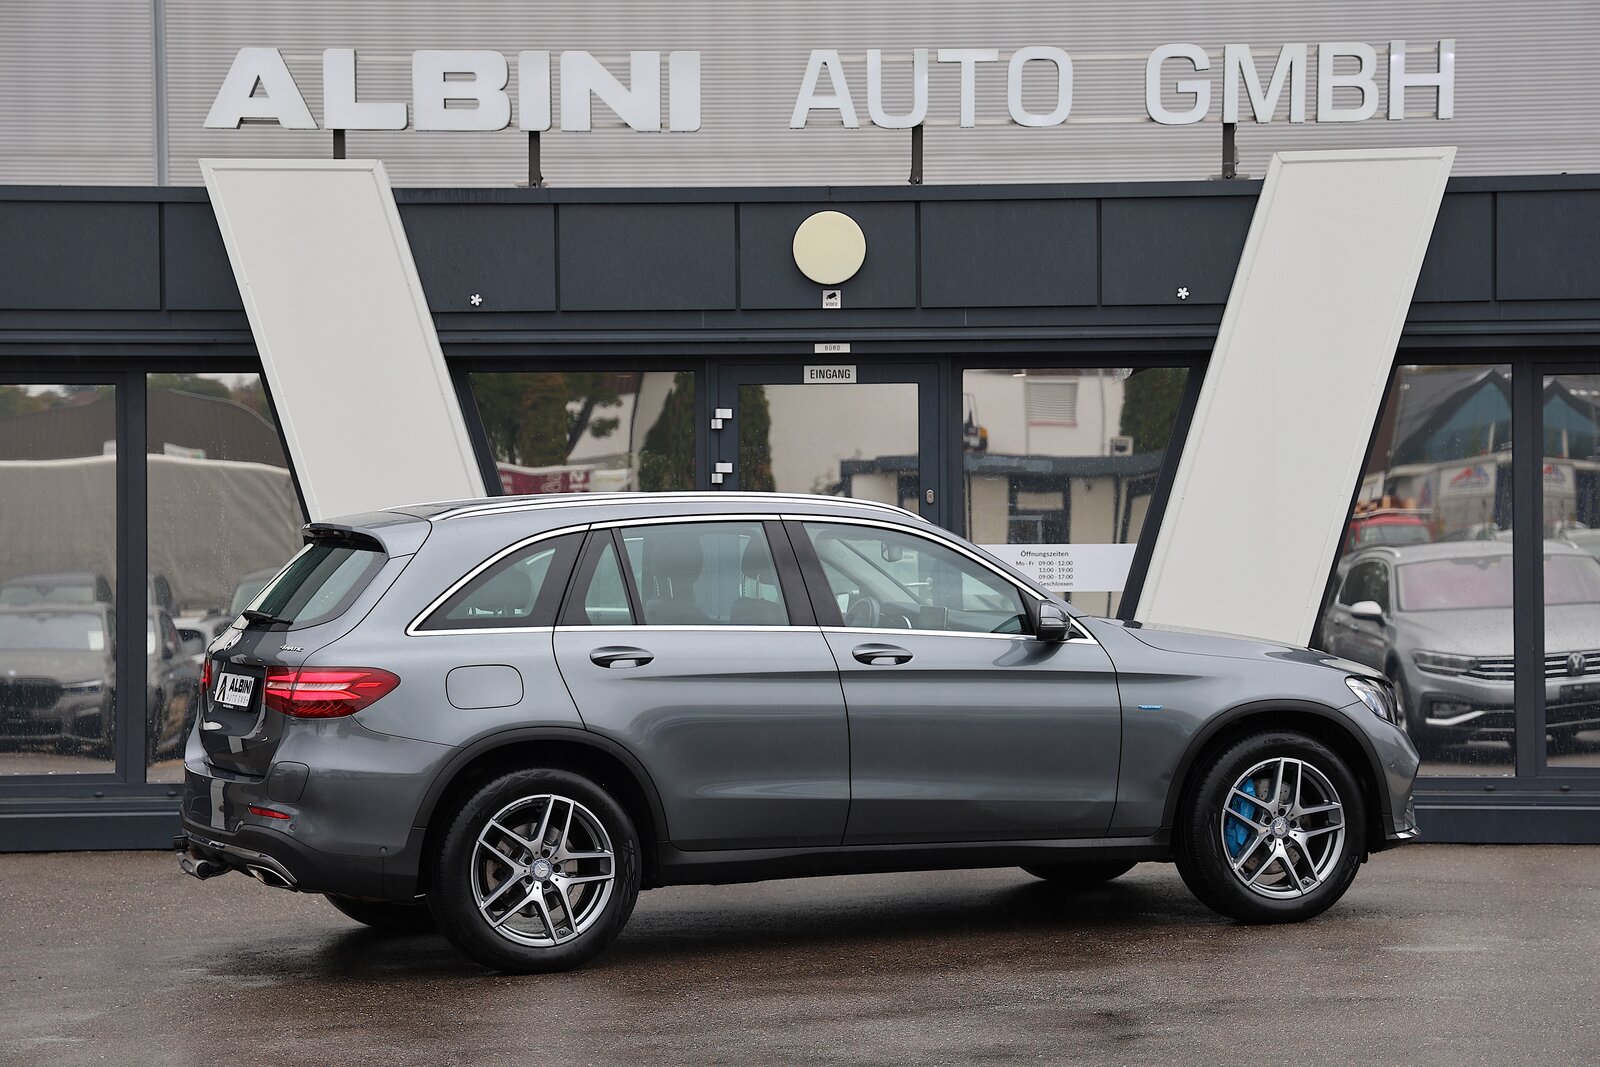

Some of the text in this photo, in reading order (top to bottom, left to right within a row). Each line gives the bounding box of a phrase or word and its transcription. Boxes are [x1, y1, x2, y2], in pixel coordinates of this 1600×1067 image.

[203, 38, 1456, 132] ALBINI AUTO GMBH
[810, 369, 851, 379] EINGANG
[229, 678, 253, 694] ALBINI
